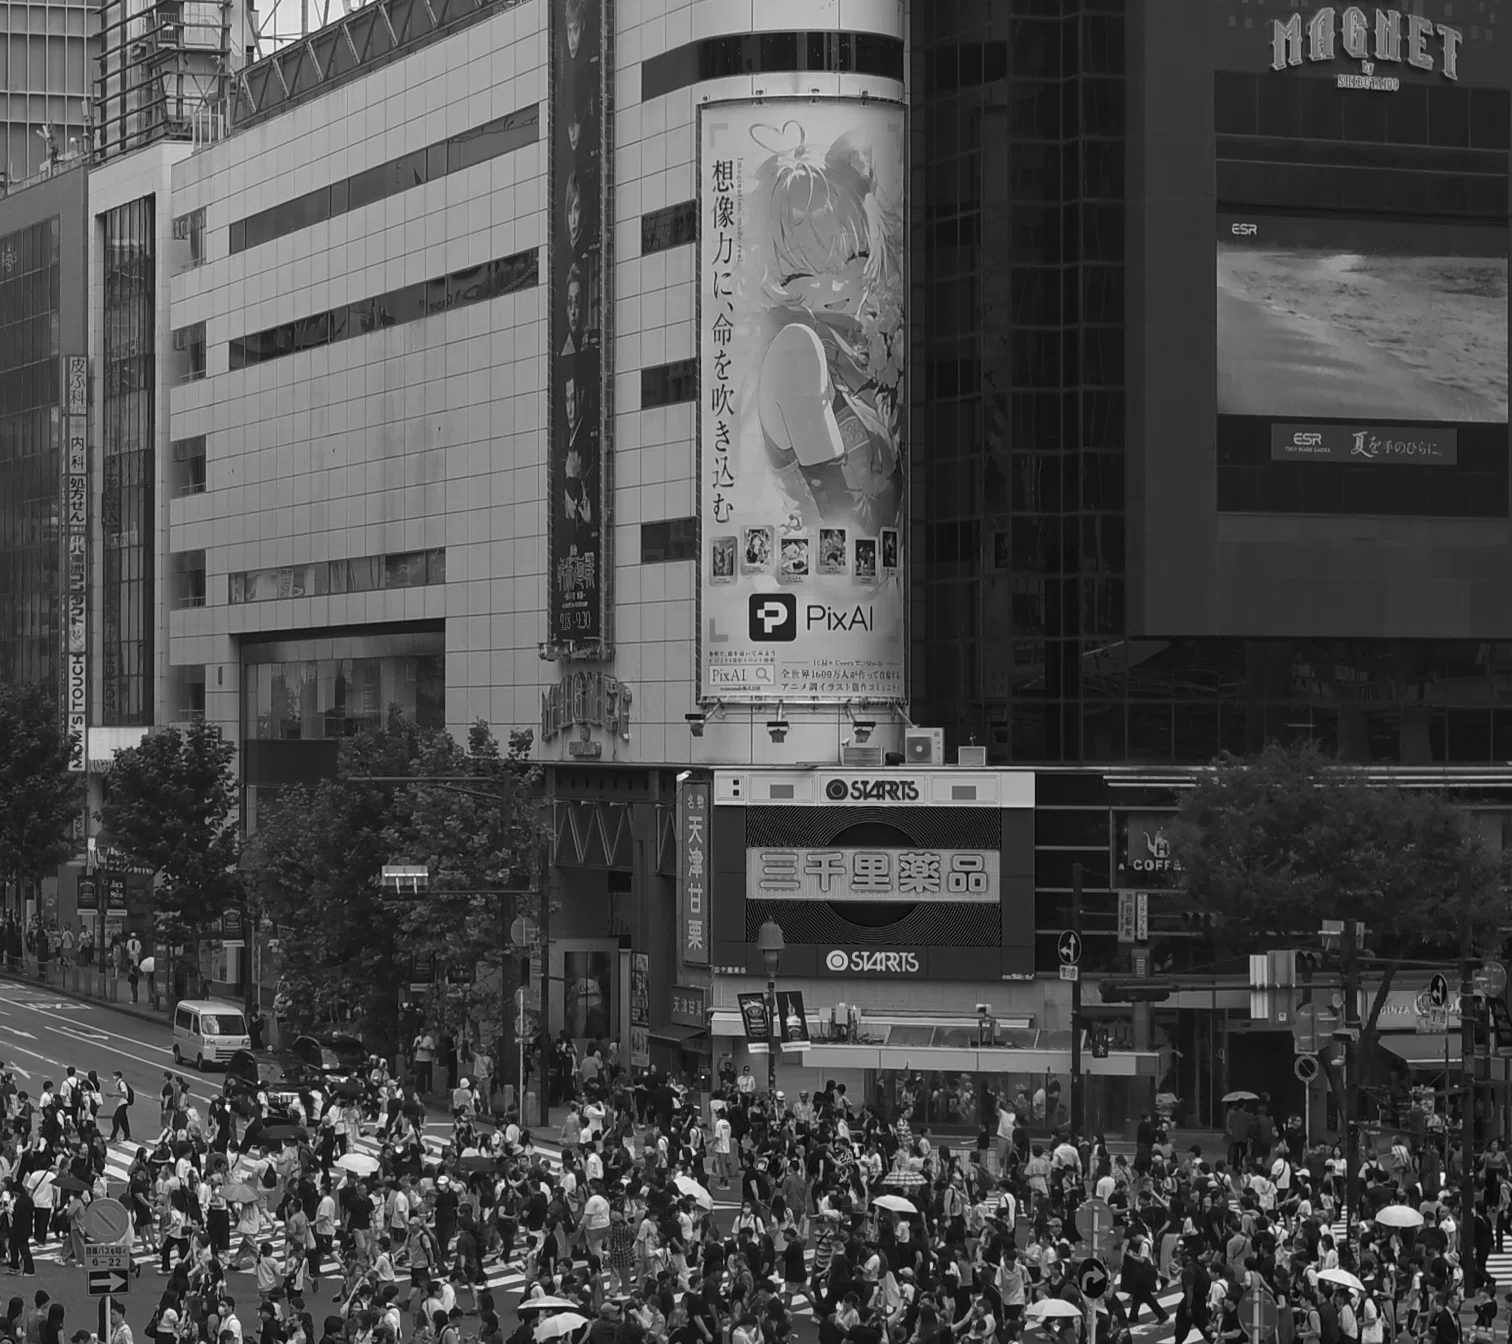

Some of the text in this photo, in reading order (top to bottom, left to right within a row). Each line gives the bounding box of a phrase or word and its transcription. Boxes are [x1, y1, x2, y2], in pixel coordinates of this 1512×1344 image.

[1269, 7, 1463, 80] MAGNET
[1231, 223, 1258, 236] ESR
[710, 159, 734, 524] 想像力に、命を吹き込む
[70, 358, 85, 405] 皮ふ科
[1294, 432, 1322, 446] ESR
[70, 477, 85, 523] 処方せん
[805, 602, 874, 633] PixAI
[72, 653, 83, 710] TOUCH
[713, 668, 747, 682] PixAI
[685, 816, 704, 952] 天津甘栗
[759, 850, 988, 895] 三千里薬品
[1380, 1006, 1411, 1016] GINZA
[92, 1258, 122, 1268] 6-22
